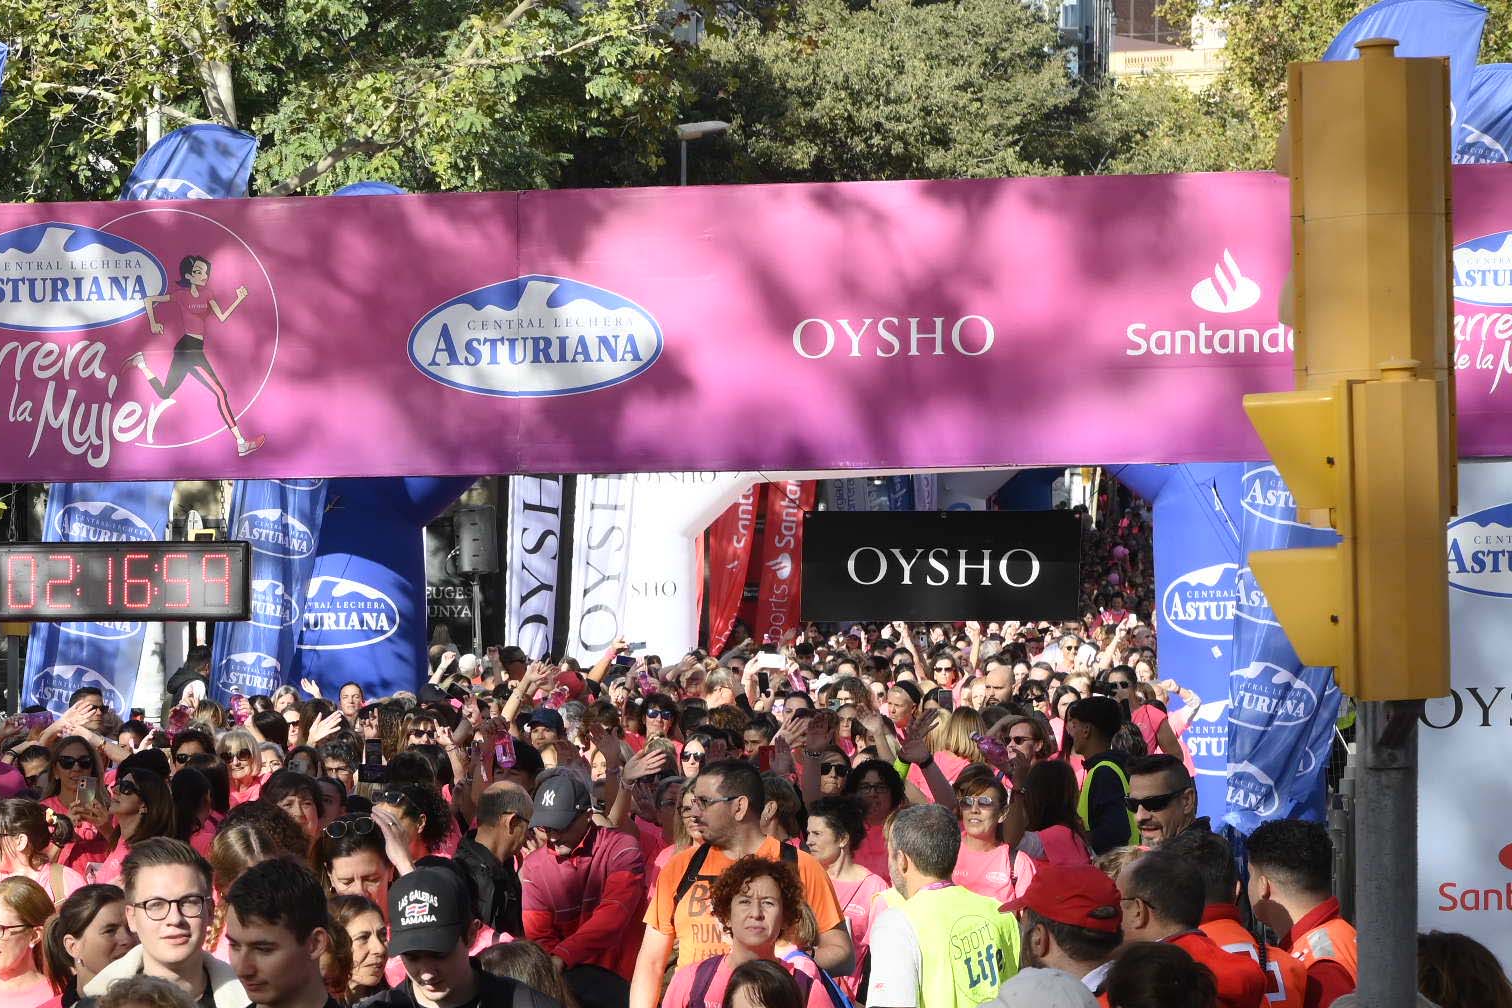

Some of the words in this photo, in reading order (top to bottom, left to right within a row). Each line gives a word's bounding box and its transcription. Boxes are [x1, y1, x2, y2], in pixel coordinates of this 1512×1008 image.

[70, 258, 143, 271] LECHERA
[467, 318, 545, 332] CENTRAL
[552, 316, 635, 330] LECHERA
[792, 314, 996, 360] OYSHO
[1126, 321, 1294, 356] Santand
[428, 323, 643, 368] ASTURIANA
[9, 386, 34, 423] la
[29, 377, 177, 468] Mujer
[7, 553, 232, 609] 02:16:59
[846, 547, 1041, 588] OYSHO
[336, 601, 386, 609] LECHERA
[398, 895, 408, 912] LAS
[408, 889, 439, 908] GALERAS
[951, 921, 995, 960] Sport
[964, 943, 1006, 989] Life
